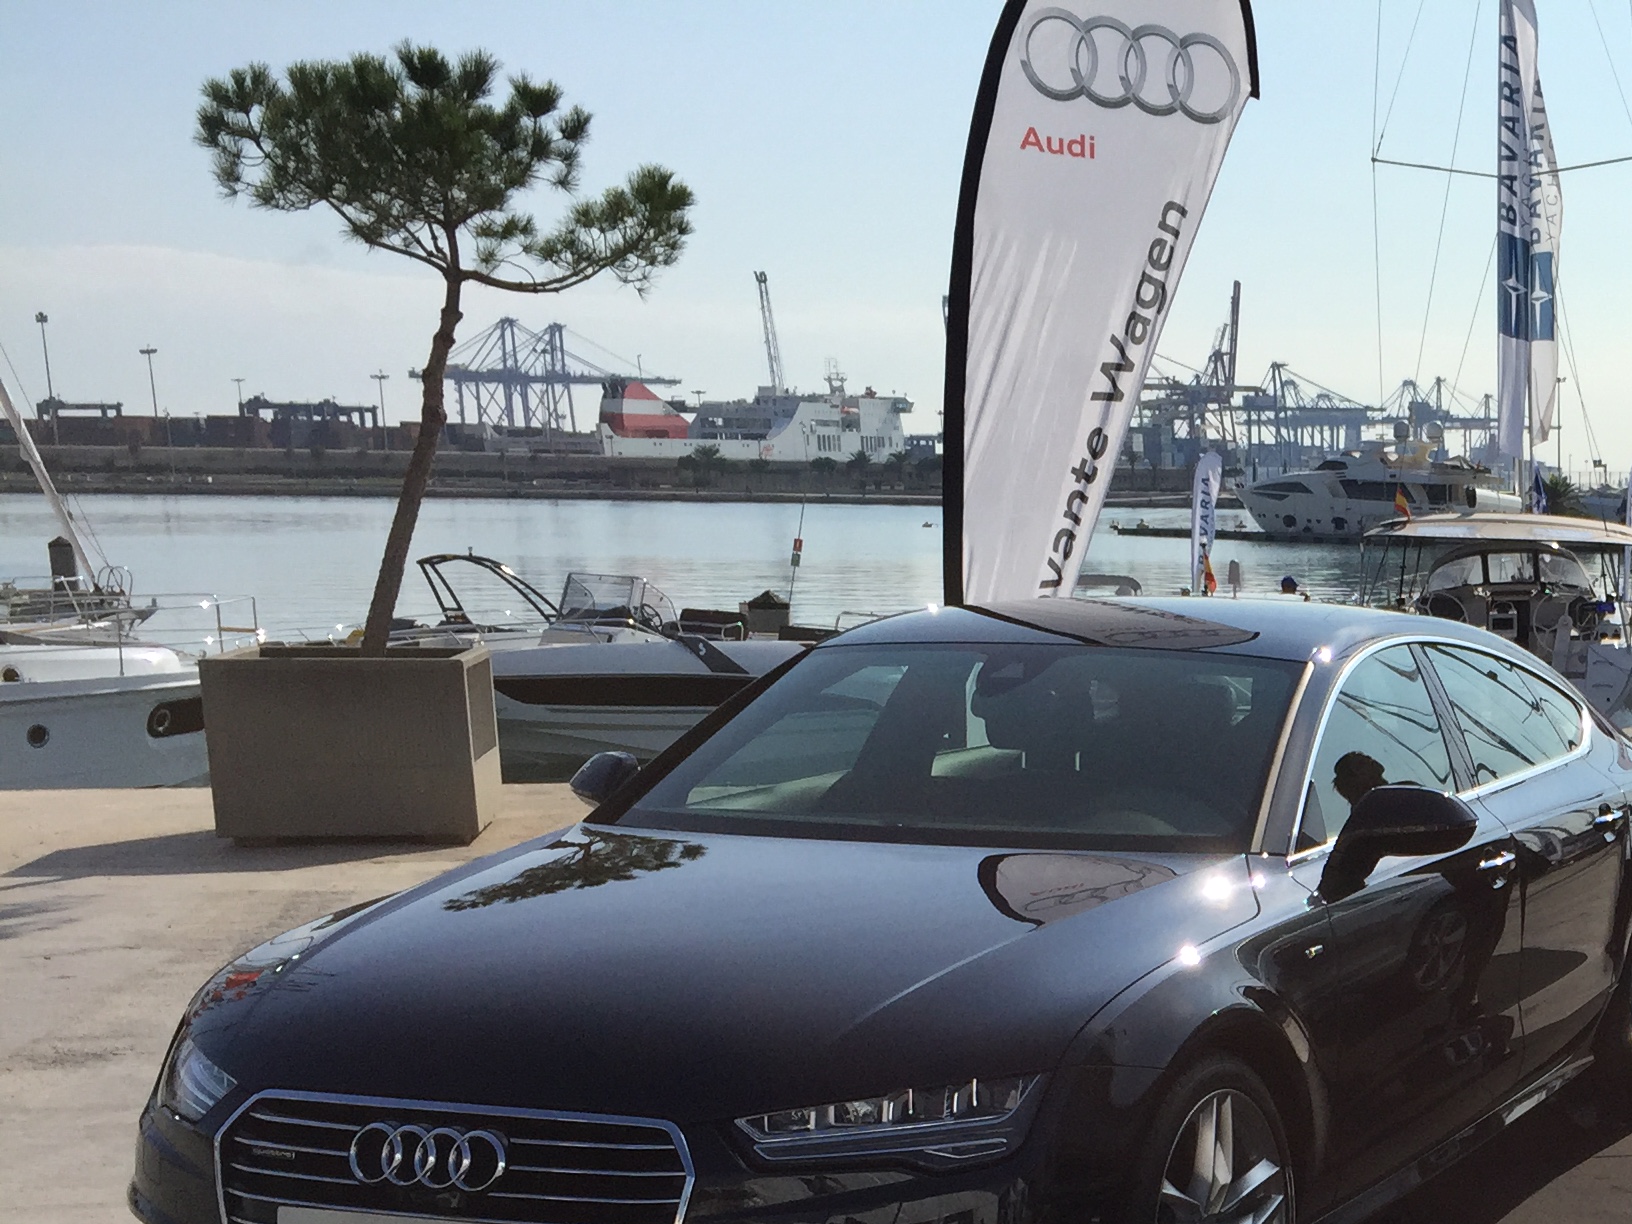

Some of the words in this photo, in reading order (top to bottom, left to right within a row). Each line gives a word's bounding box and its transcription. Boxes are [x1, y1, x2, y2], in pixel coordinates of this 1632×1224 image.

[1019, 126, 1096, 159] Audi
[1500, 34, 1522, 227] BAVARIA
[1038, 426, 1109, 598] vante
[1090, 200, 1189, 402] Wagen
